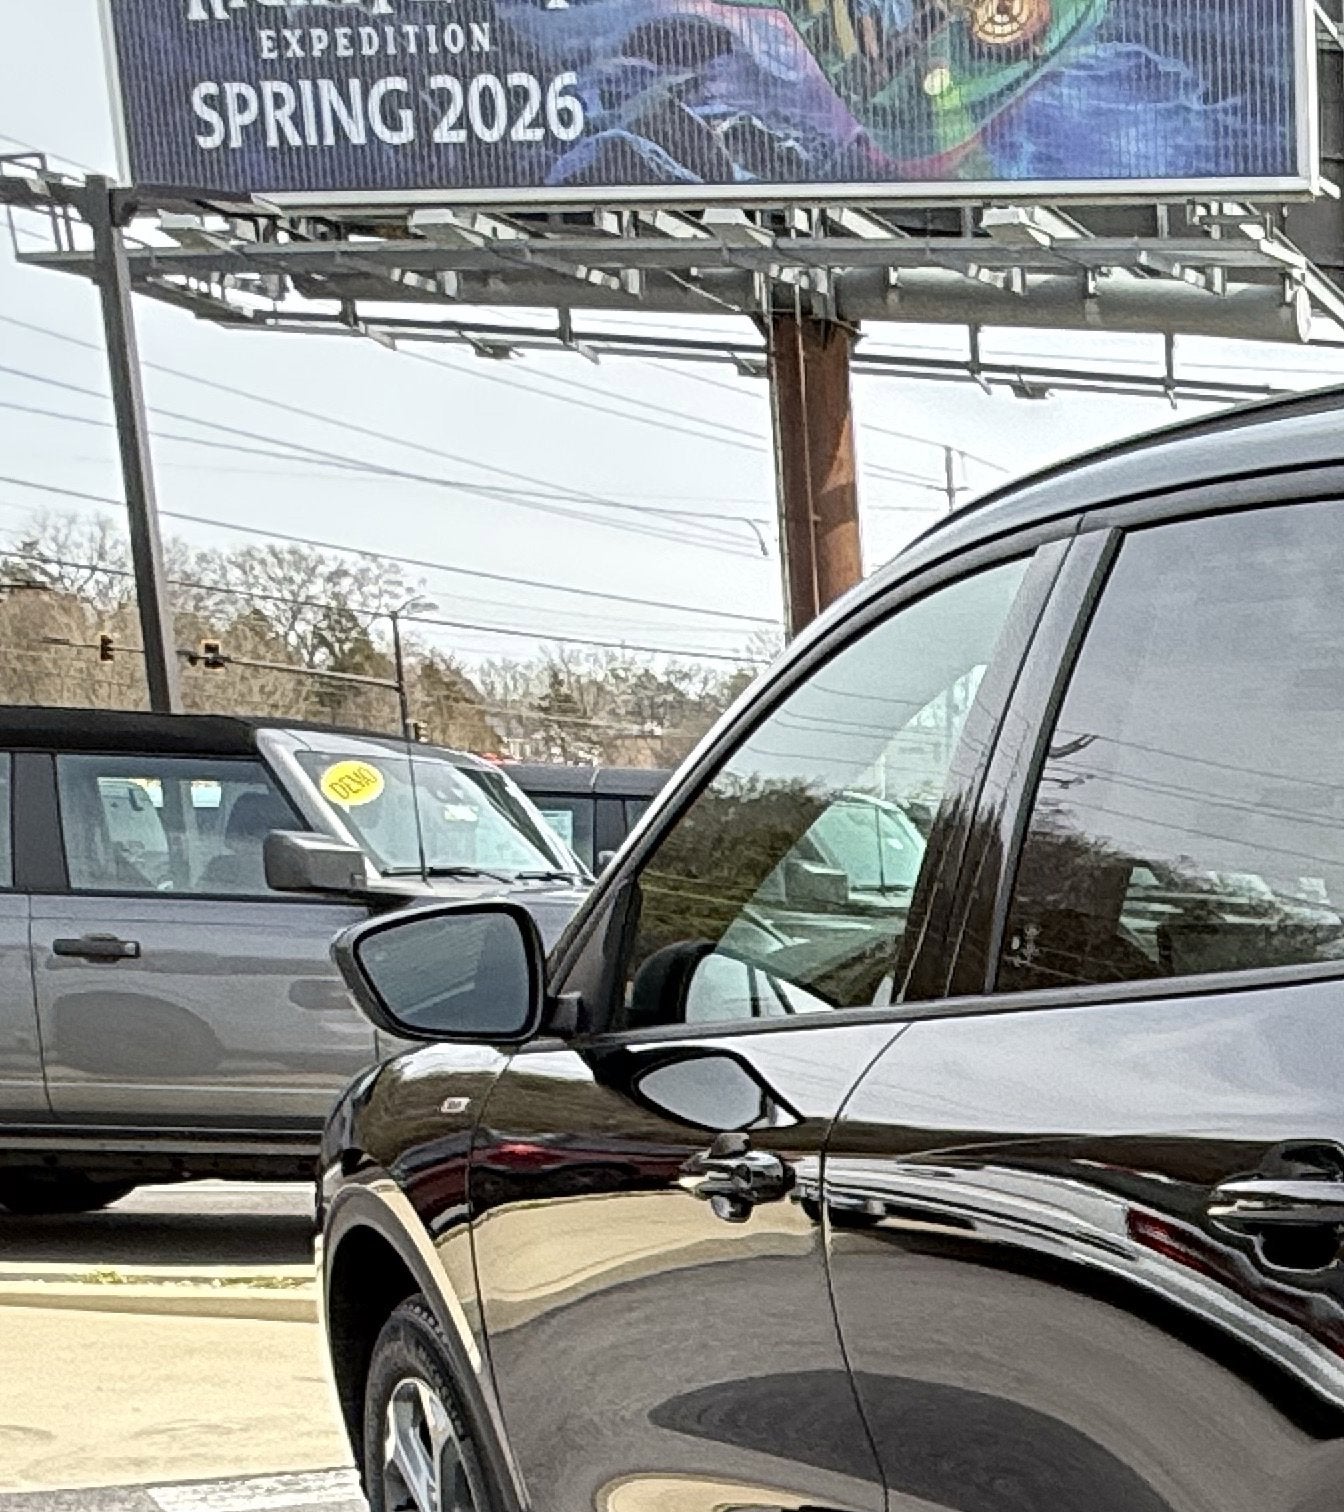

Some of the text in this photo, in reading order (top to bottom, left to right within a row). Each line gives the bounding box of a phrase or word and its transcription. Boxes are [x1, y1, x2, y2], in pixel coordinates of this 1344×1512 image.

[259, 22, 492, 60] EXPEDITION
[192, 72, 585, 149] SPRING 2026
[328, 767, 378, 799] DEMO
